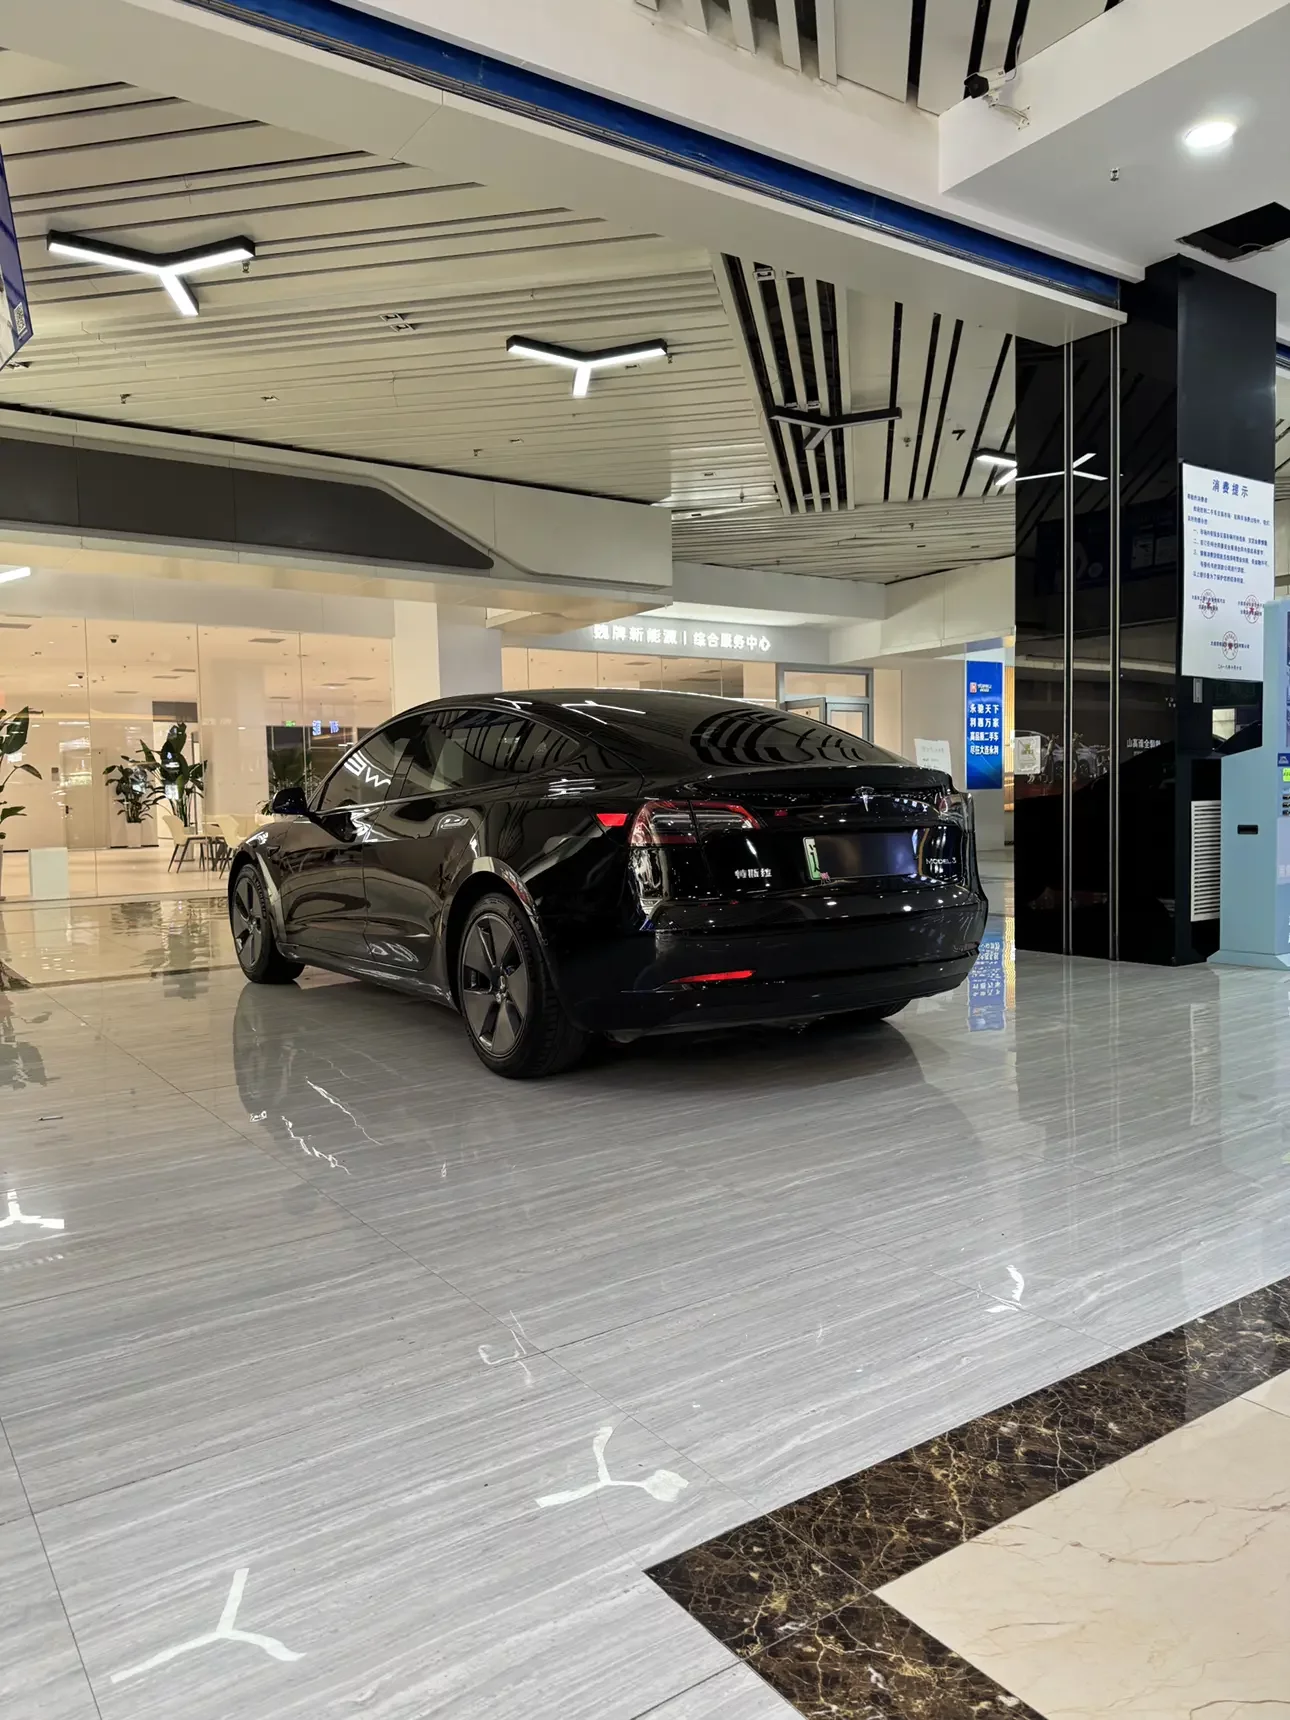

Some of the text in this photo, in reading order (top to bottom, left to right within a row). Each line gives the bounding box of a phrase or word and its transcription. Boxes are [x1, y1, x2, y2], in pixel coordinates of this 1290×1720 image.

[1212, 479, 1248, 498] 消费提示
[593, 624, 771, 652] 魏牌新能源 综合服务中心
[734, 868, 772, 879] 特斯拉
